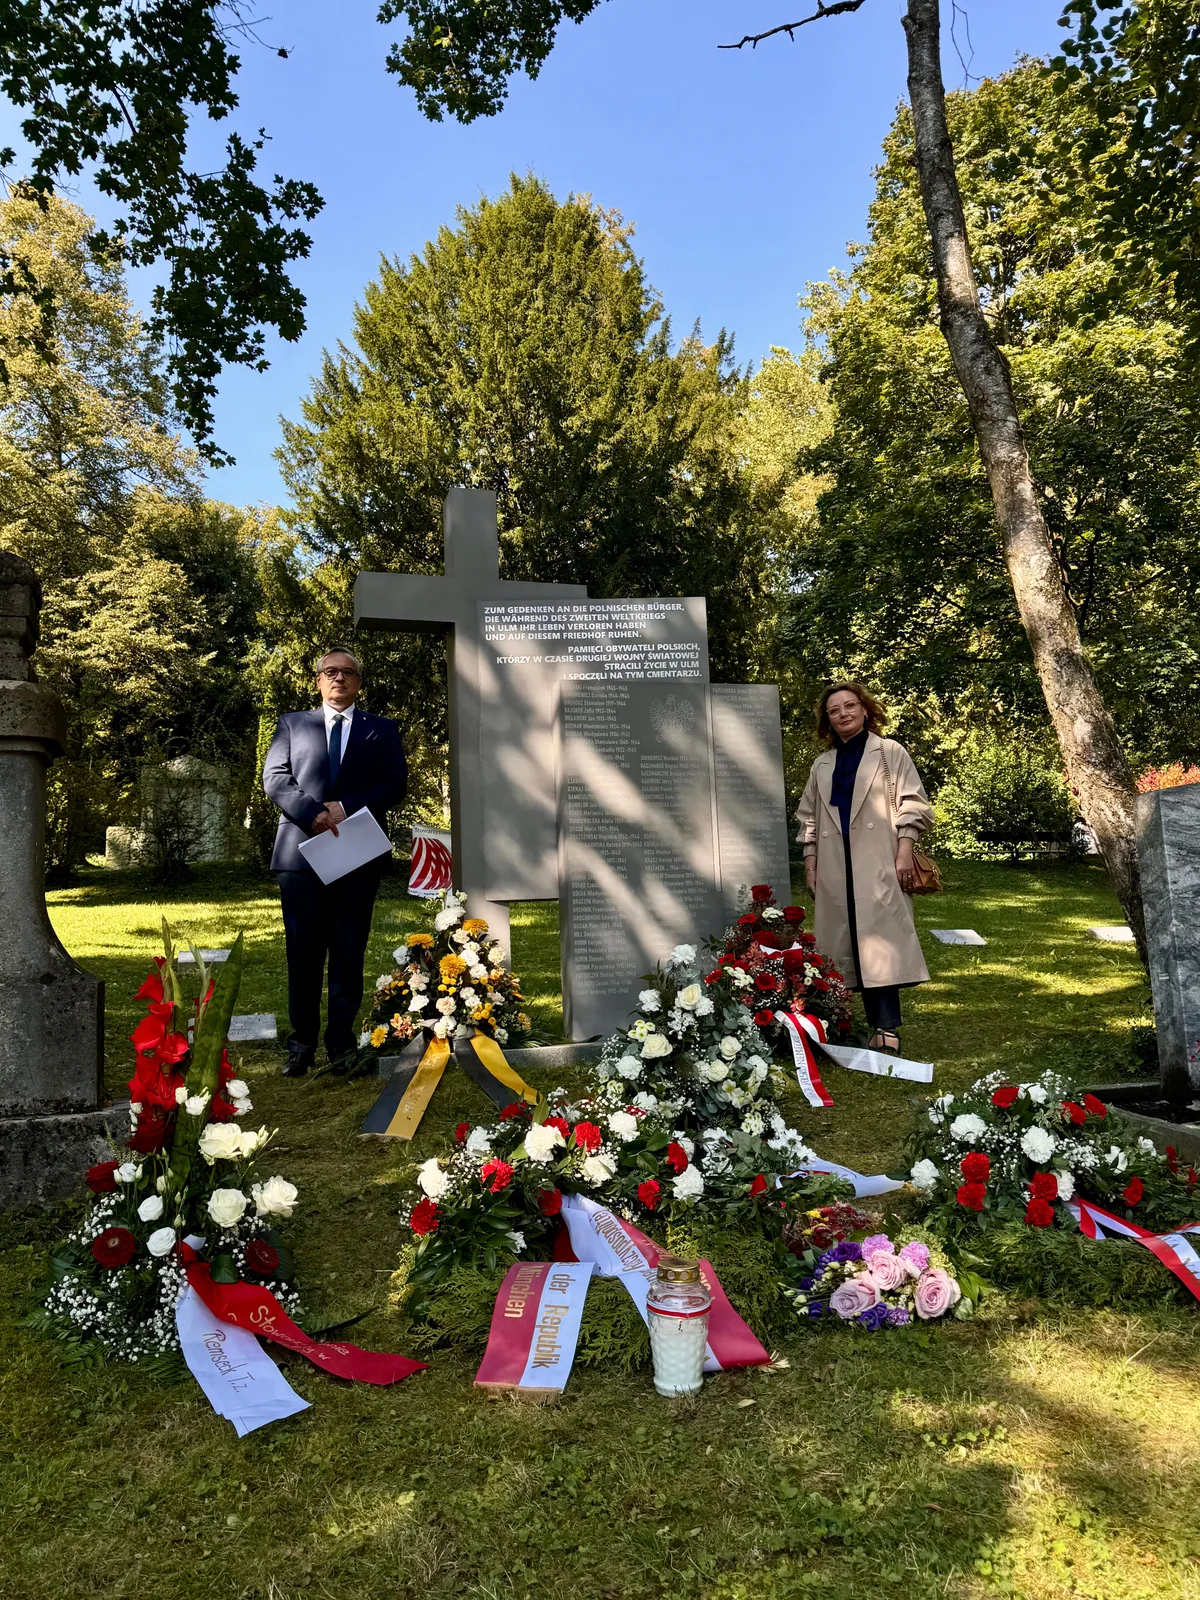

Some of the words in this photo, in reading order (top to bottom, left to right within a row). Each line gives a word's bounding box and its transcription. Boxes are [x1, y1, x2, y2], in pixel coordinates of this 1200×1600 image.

[589, 604, 644, 612] POLNISCHEN
[647, 602, 684, 612] BÜRGER,
[502, 614, 548, 622] WÄHREND
[551, 614, 567, 622] DES
[611, 613, 666, 621] WELTKRIEGS
[538, 623, 565, 631] LEBEN
[567, 622, 613, 630] VERLOREN
[485, 633, 505, 641] UND
[529, 632, 561, 640] DIESEM
[563, 631, 606, 639] FRIEDHOF
[608, 630, 642, 638] RUHEN.
[568, 645, 603, 655] PAMIĘCI
[605, 644, 655, 653] OBYWATELI
[657, 643, 701, 652] POLSKICH,
[496, 655, 531, 664] KTÓRZY
[544, 655, 574, 663] CZASIE
[576, 654, 612, 662] DRUGIEJ
[614, 653, 645, 661] WOJNY
[647, 651, 699, 660] ŚWIATOWEJ
[604, 662, 641, 670] STRACILI
[643, 660, 667, 669] ŻYCIE
[568, 672, 608, 681] SPOCZĘLI
[625, 671, 644, 679] TYM
[646, 670, 702, 678] CMENTARZU.
[549, 1273, 576, 1294] der
[504, 1265, 545, 1318] München
[531, 1304, 569, 1369] Republik
[203, 1329, 247, 1376] Remseck
